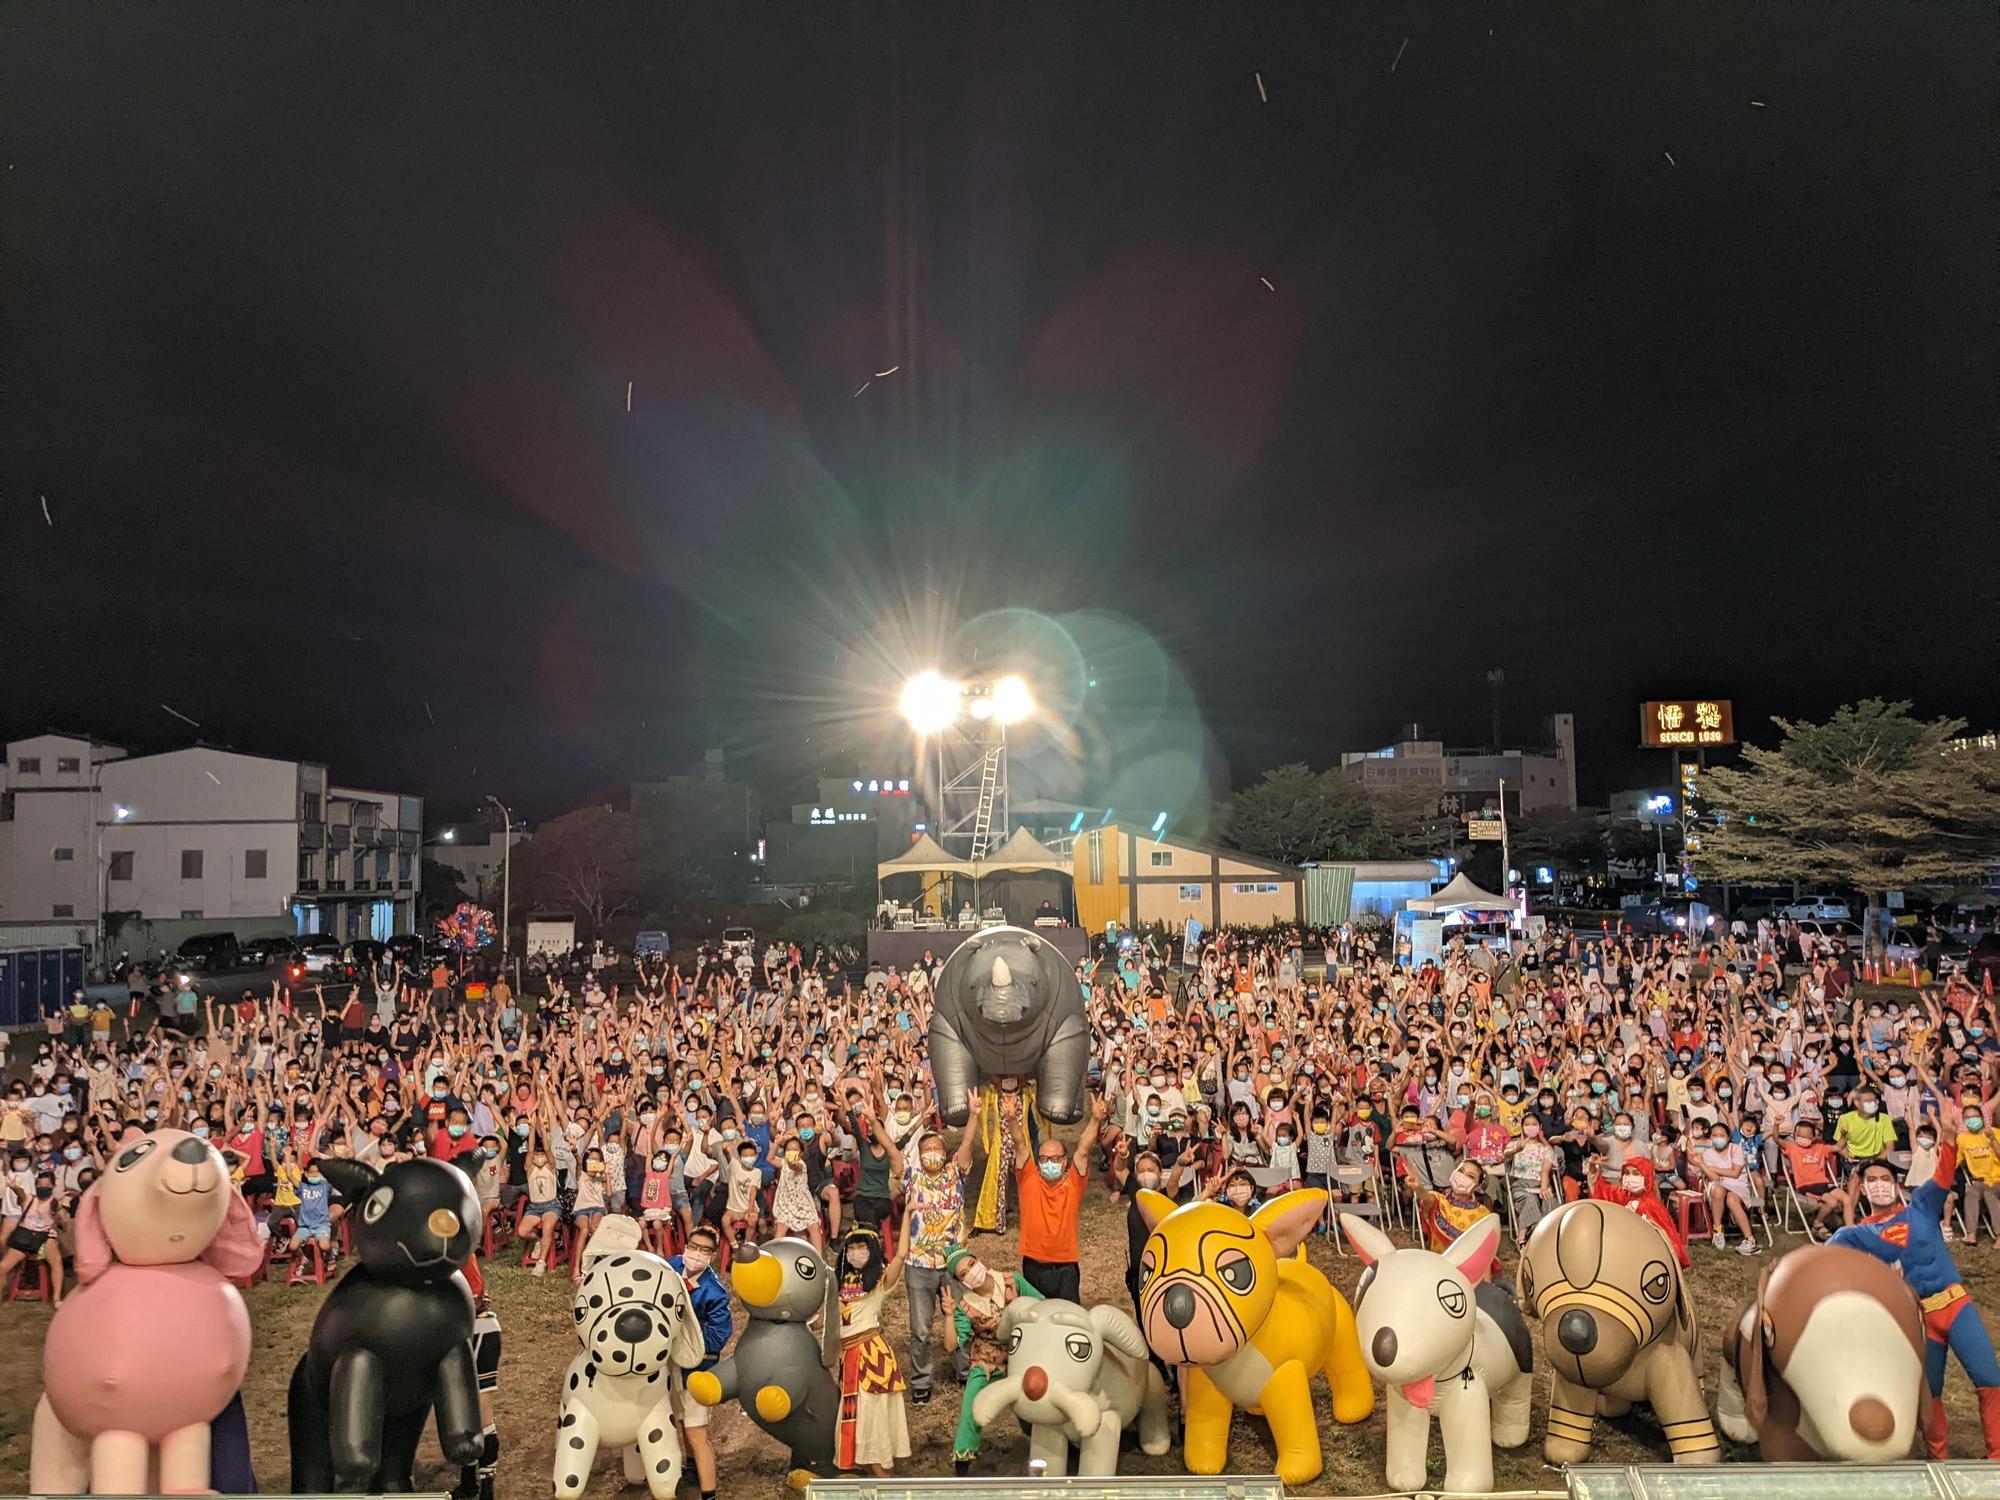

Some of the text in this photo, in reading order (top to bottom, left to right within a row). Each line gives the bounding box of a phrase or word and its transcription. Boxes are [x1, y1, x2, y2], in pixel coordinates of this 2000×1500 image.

[1660, 731, 1695, 743] SINCE
[1441, 795, 1460, 814] 林
[303, 1189, 323, 1200] RUN
